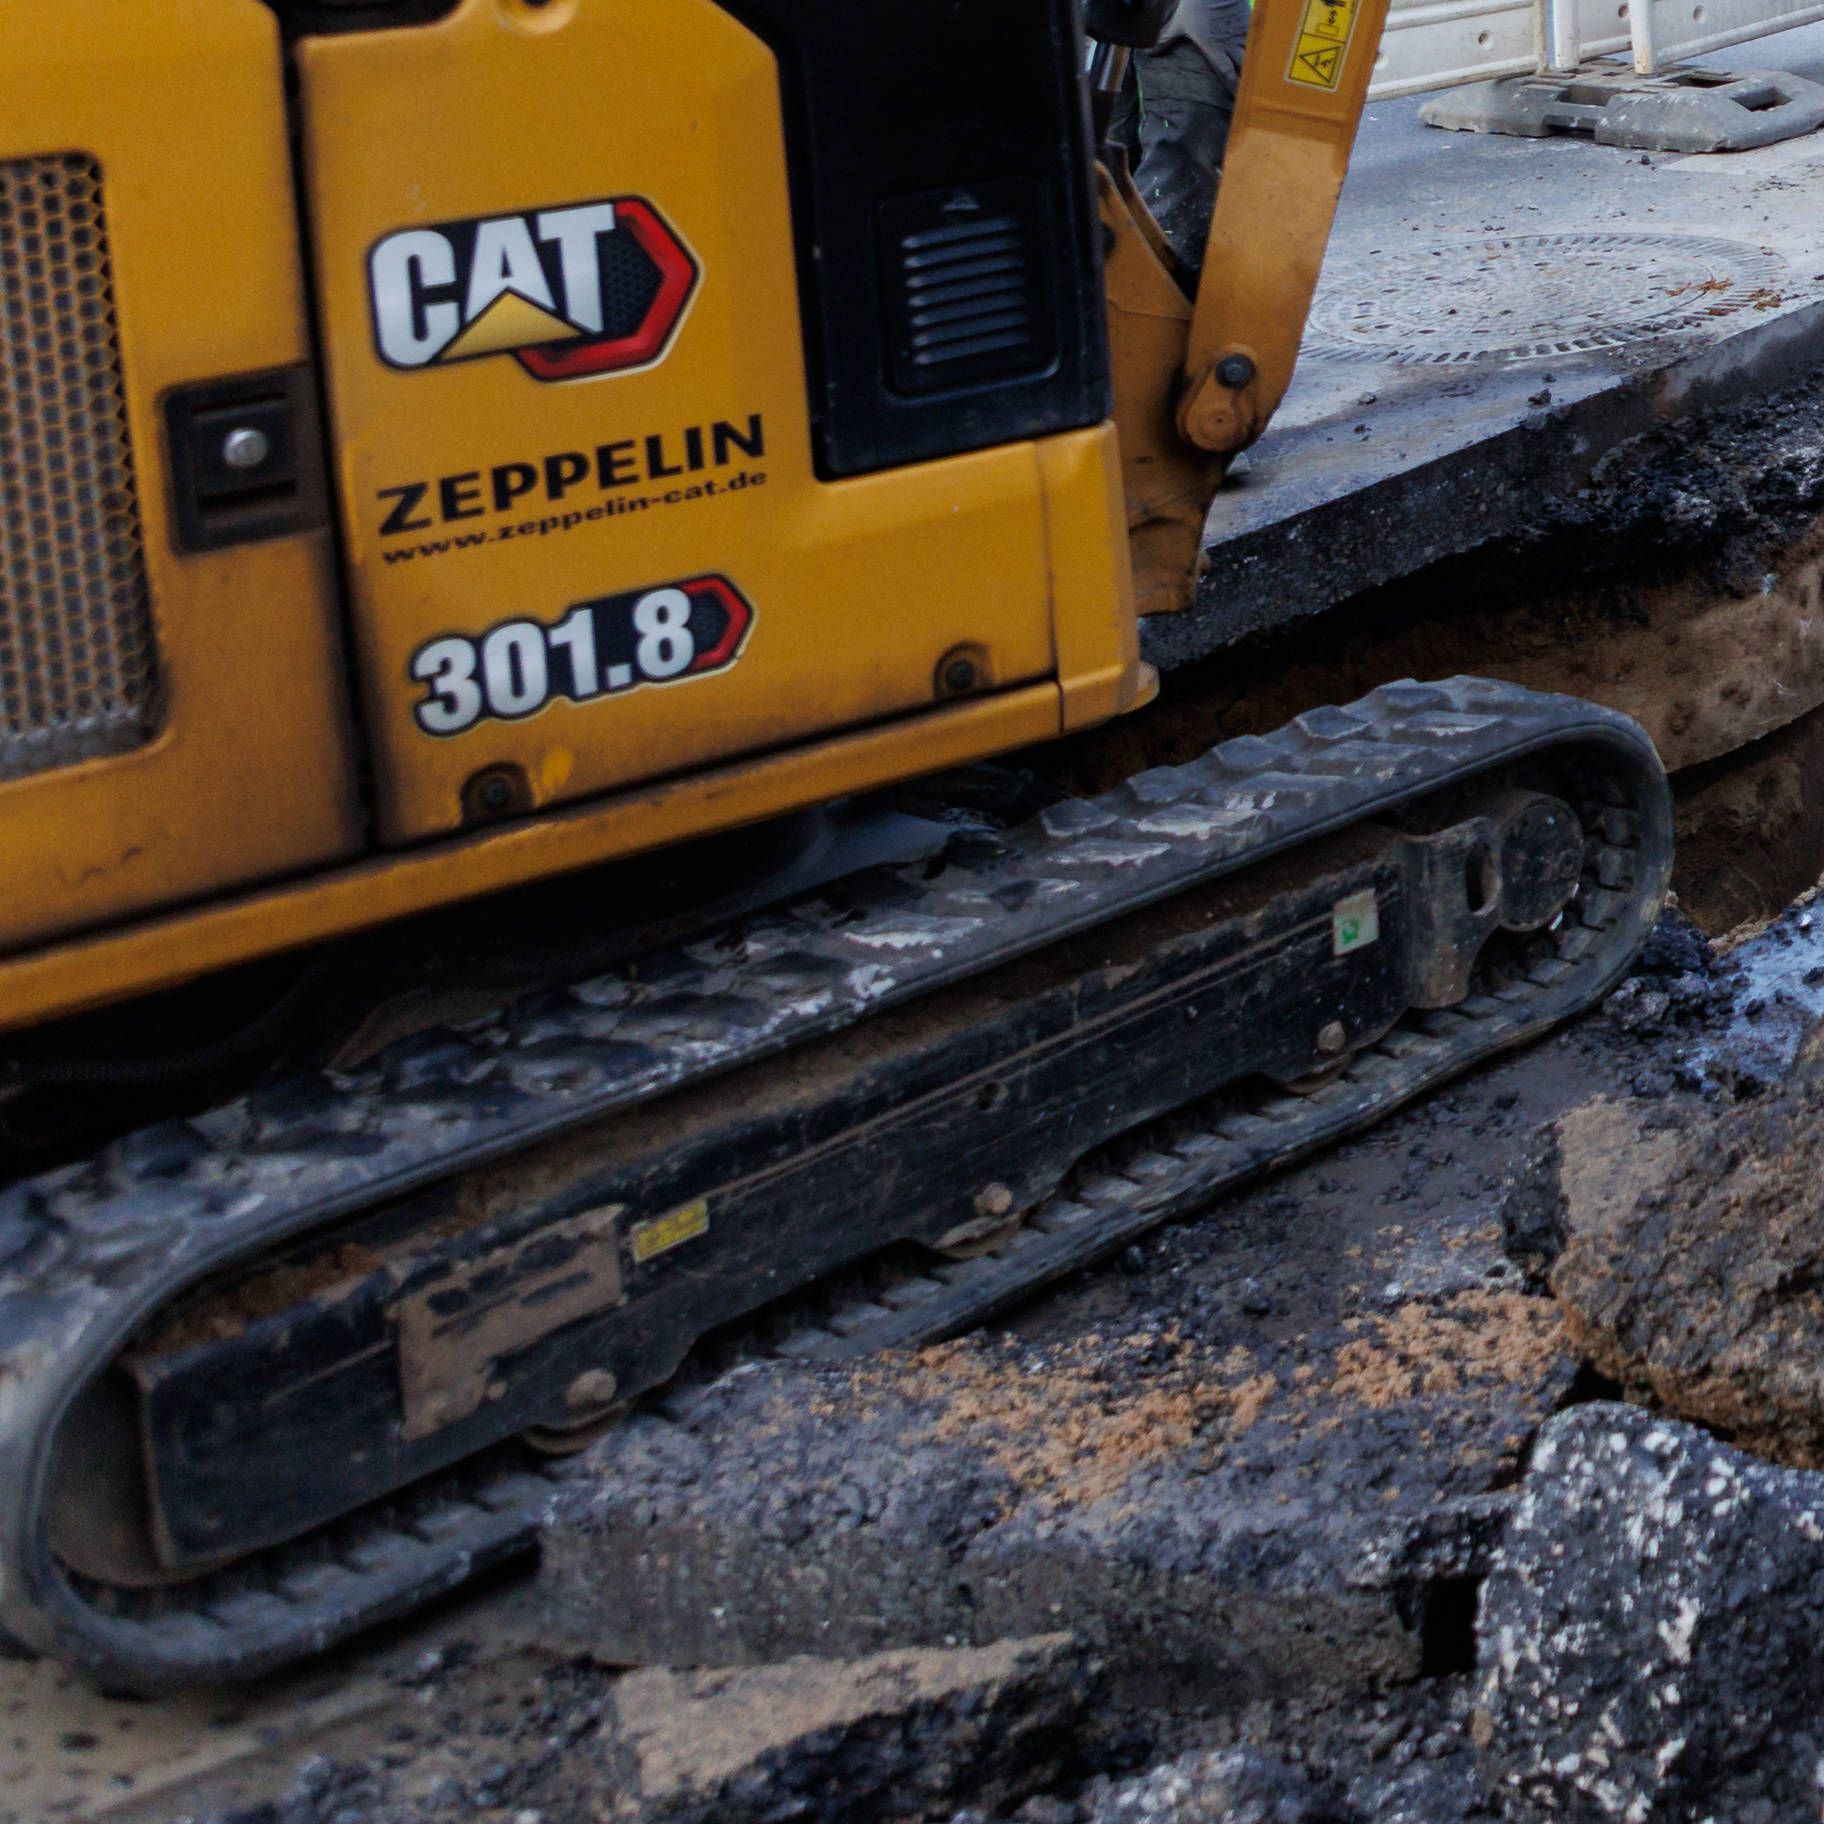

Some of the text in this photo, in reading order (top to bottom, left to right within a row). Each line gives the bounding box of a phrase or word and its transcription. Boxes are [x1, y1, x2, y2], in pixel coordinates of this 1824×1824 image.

[371, 202, 616, 367] CAT
[377, 413, 766, 538] ZEPPELIN
[381, 468, 768, 565] www.zeppelin-cat.de
[413, 587, 696, 733] 301.8
